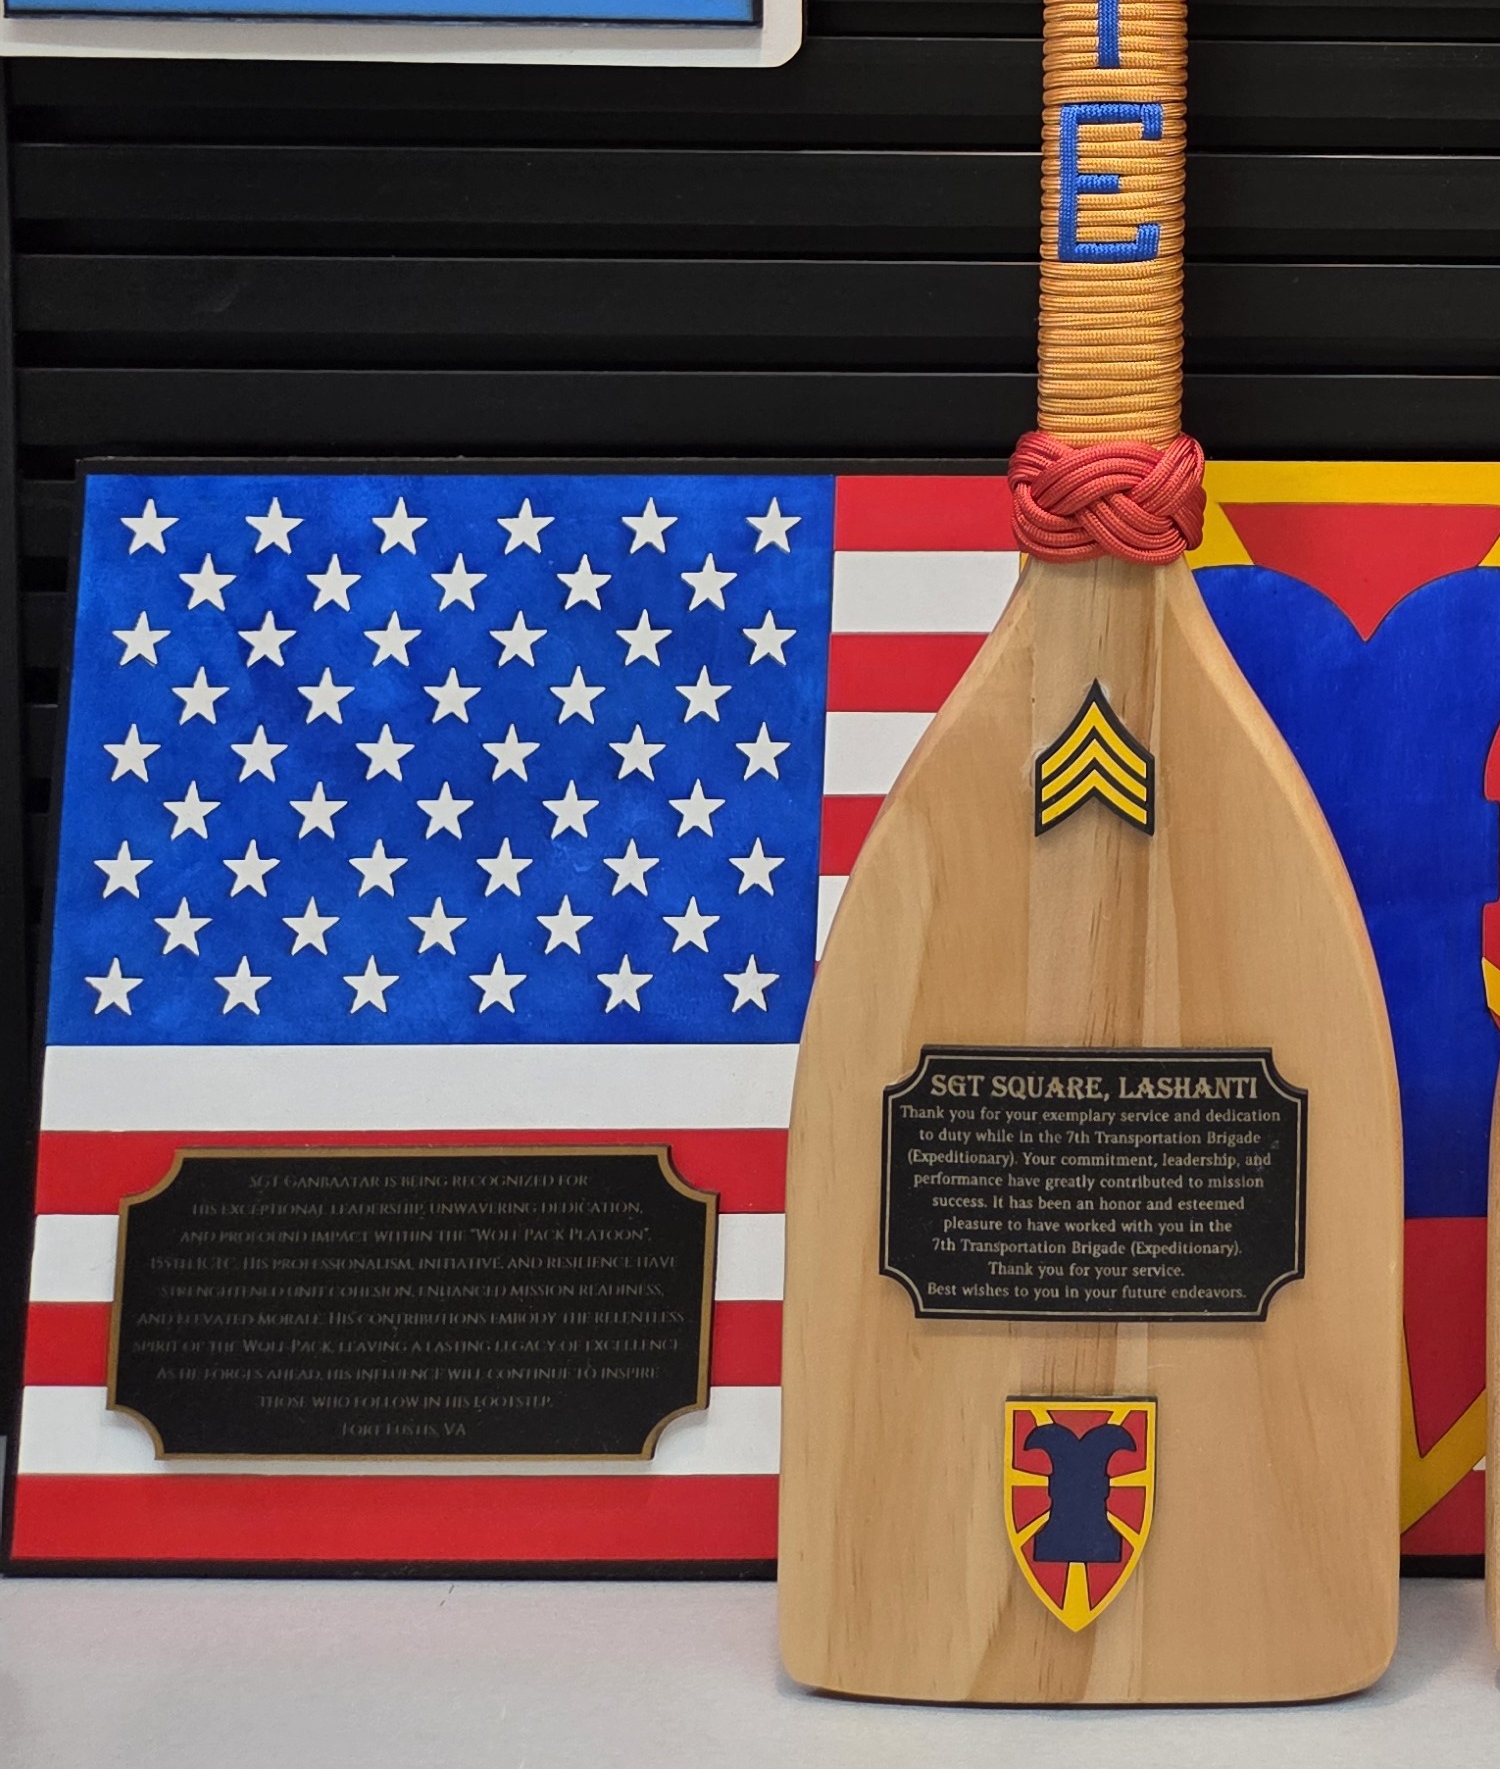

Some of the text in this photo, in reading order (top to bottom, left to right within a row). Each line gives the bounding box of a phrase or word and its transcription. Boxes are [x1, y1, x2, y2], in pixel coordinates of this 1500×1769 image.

[930, 1074, 1258, 1103] SGT SQUARE, LASHANTI
[899, 1104, 1281, 1126] Thank you for your exemplary service and dedication
[919, 1127, 1262, 1148] to duty while in the 7th Transportation Brigade
[907, 1148, 1272, 1170] (Expeditionary). Your commitment, leadership, and
[913, 1171, 1264, 1192] performance have greatly contributed to mission
[932, 1195, 1245, 1211] success. It has been an honor and esteemed
[943, 1215, 1233, 1236] pleasure to have worked with you in the
[932, 1237, 1242, 1259] 7th Transportation Brigade (Expeditionary).
[987, 1260, 1185, 1281] Thank you for your service.
[927, 1281, 1246, 1302] Best wishes to you in your future endeavors.
